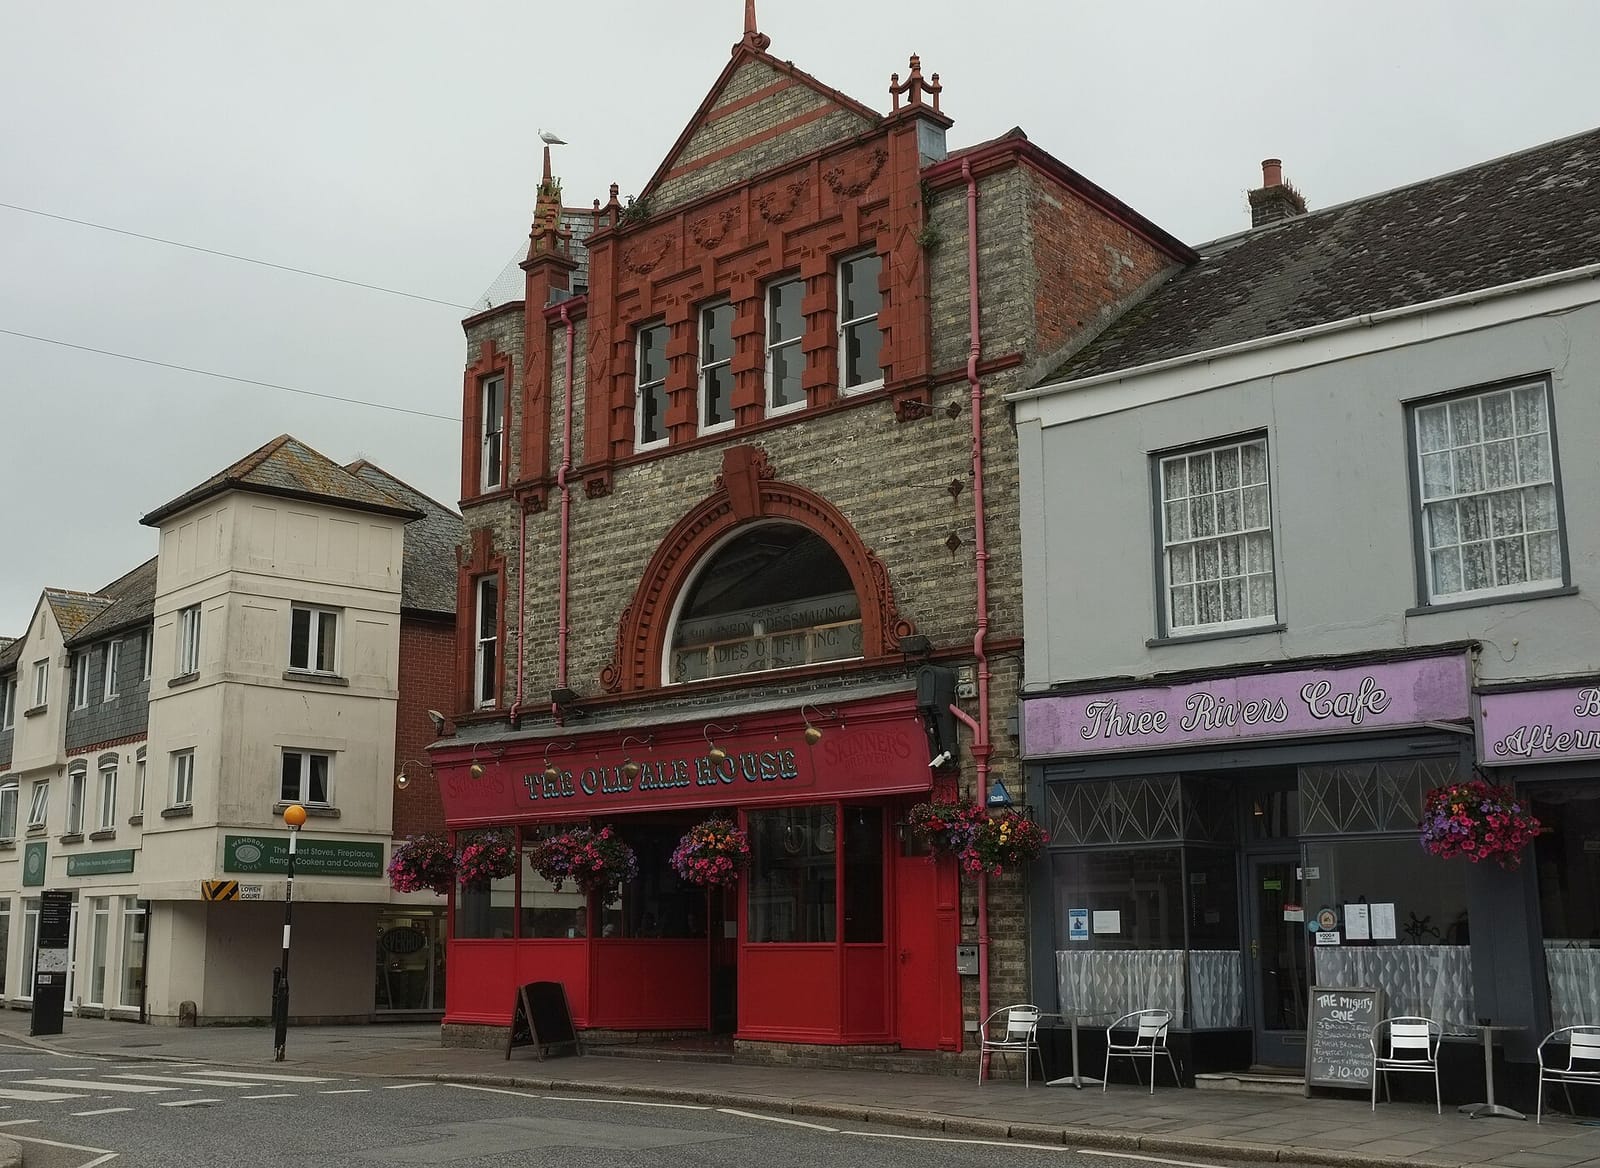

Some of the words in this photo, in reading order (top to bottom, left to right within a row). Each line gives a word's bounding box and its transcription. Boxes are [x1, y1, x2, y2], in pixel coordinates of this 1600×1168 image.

[1081, 698, 1169, 740] Three
[1180, 692, 1289, 732] Rivers
[1300, 676, 1392, 725] Cafe
[524, 770, 576, 800] THE
[581, 765, 634, 795] OLD
[639, 759, 690, 792] ALE
[695, 748, 799, 785] HOUSE
[231, 837, 265, 849] WENDRON
[273, 846, 288, 855] The
[310, 848, 336, 858] Stoves,
[337, 849, 376, 859] Fireplaces,
[233, 860, 262, 871] STOVES
[269, 856, 290, 867] Rang
[295, 858, 325, 867] Cookers
[326, 859, 342, 868] and
[343, 860, 379, 868] Cookware
[1317, 994, 1337, 1008] THE
[1331, 1010, 1355, 1021] ONE
